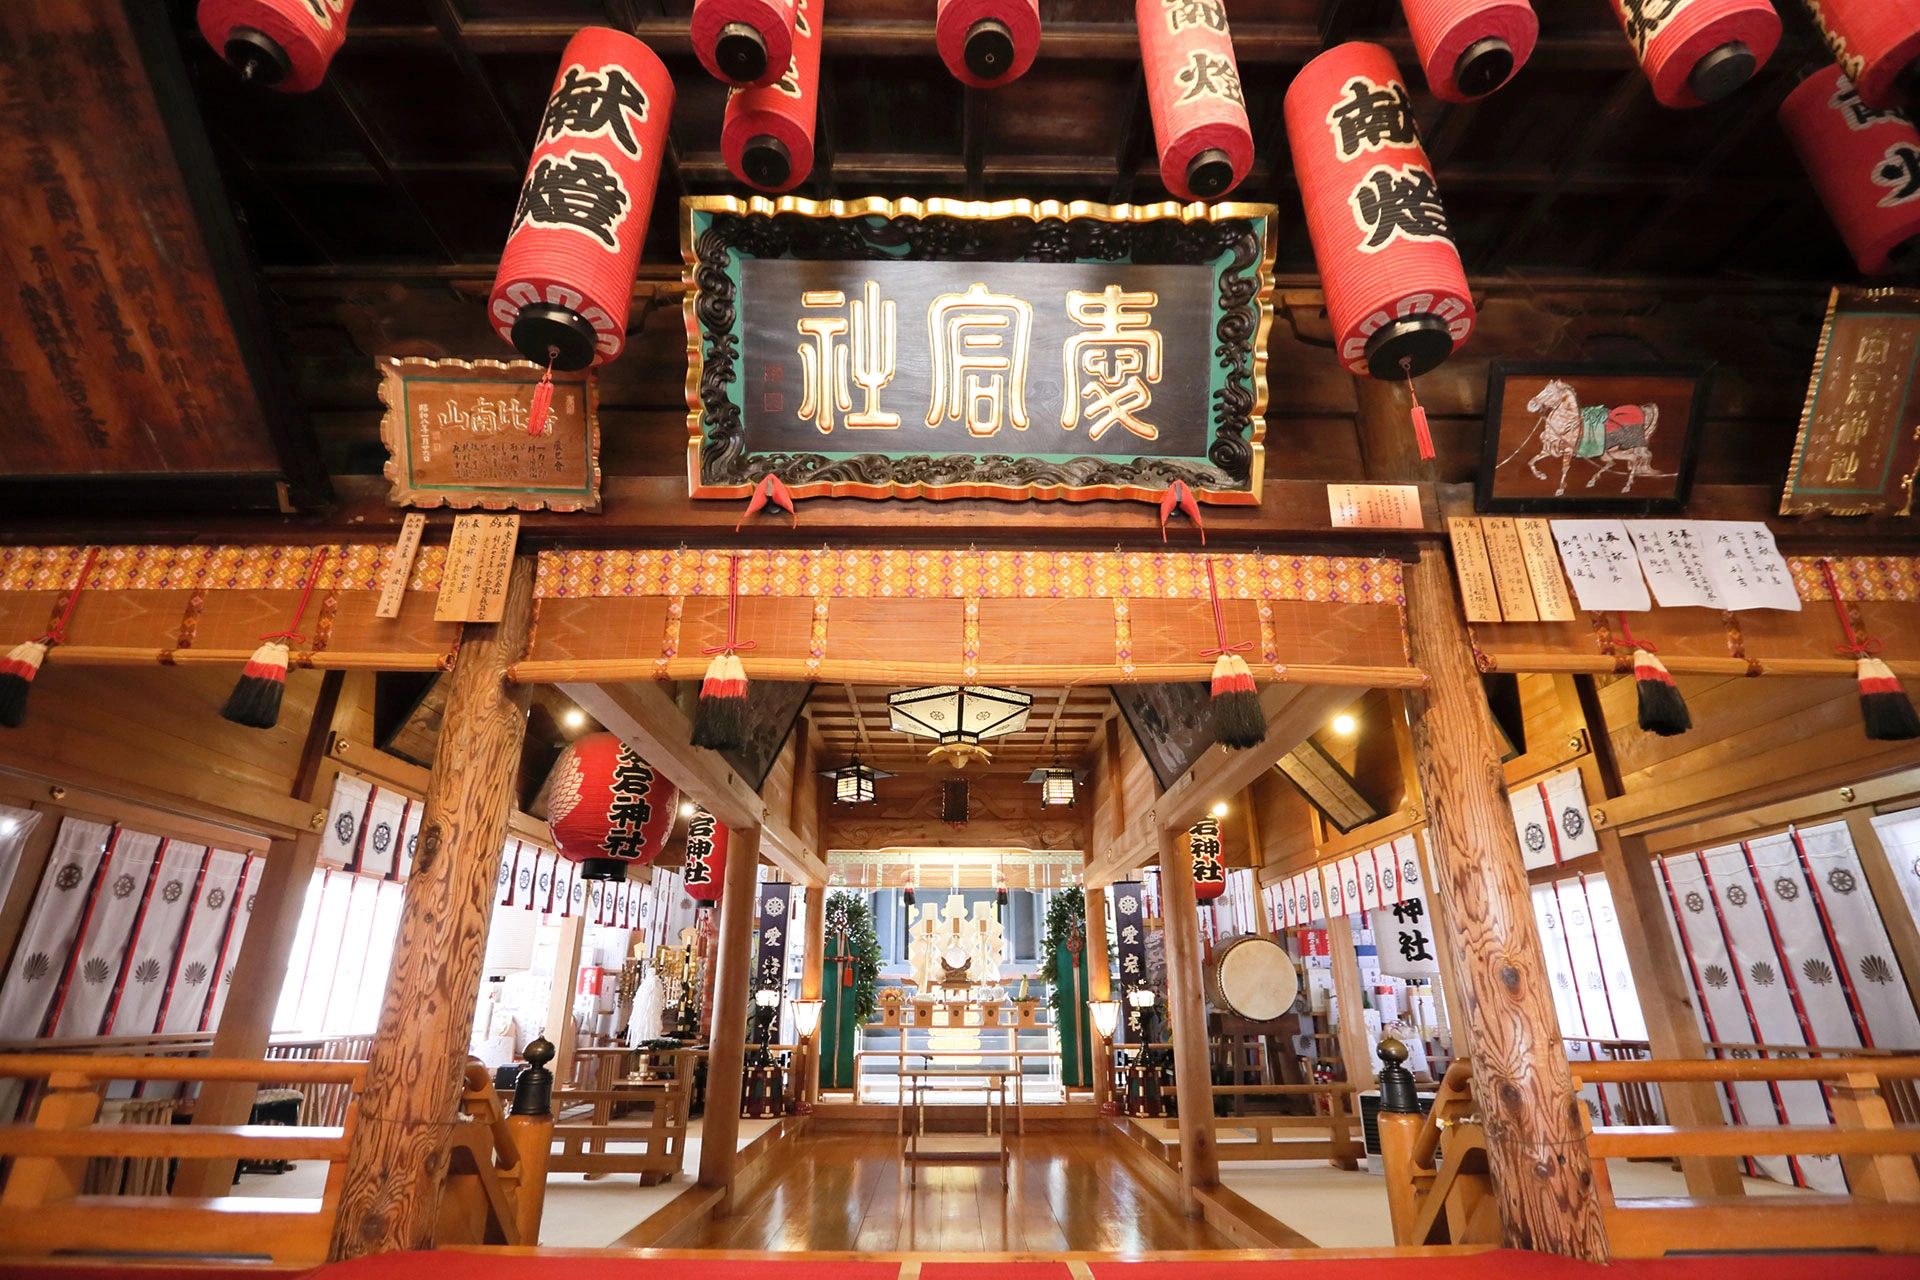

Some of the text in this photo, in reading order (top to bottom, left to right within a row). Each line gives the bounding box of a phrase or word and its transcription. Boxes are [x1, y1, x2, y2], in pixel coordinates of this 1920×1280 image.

[508, 65, 648, 251] 献燈
[685, 803, 717, 884] 宕神社
[1392, 897, 1434, 962] 神社
